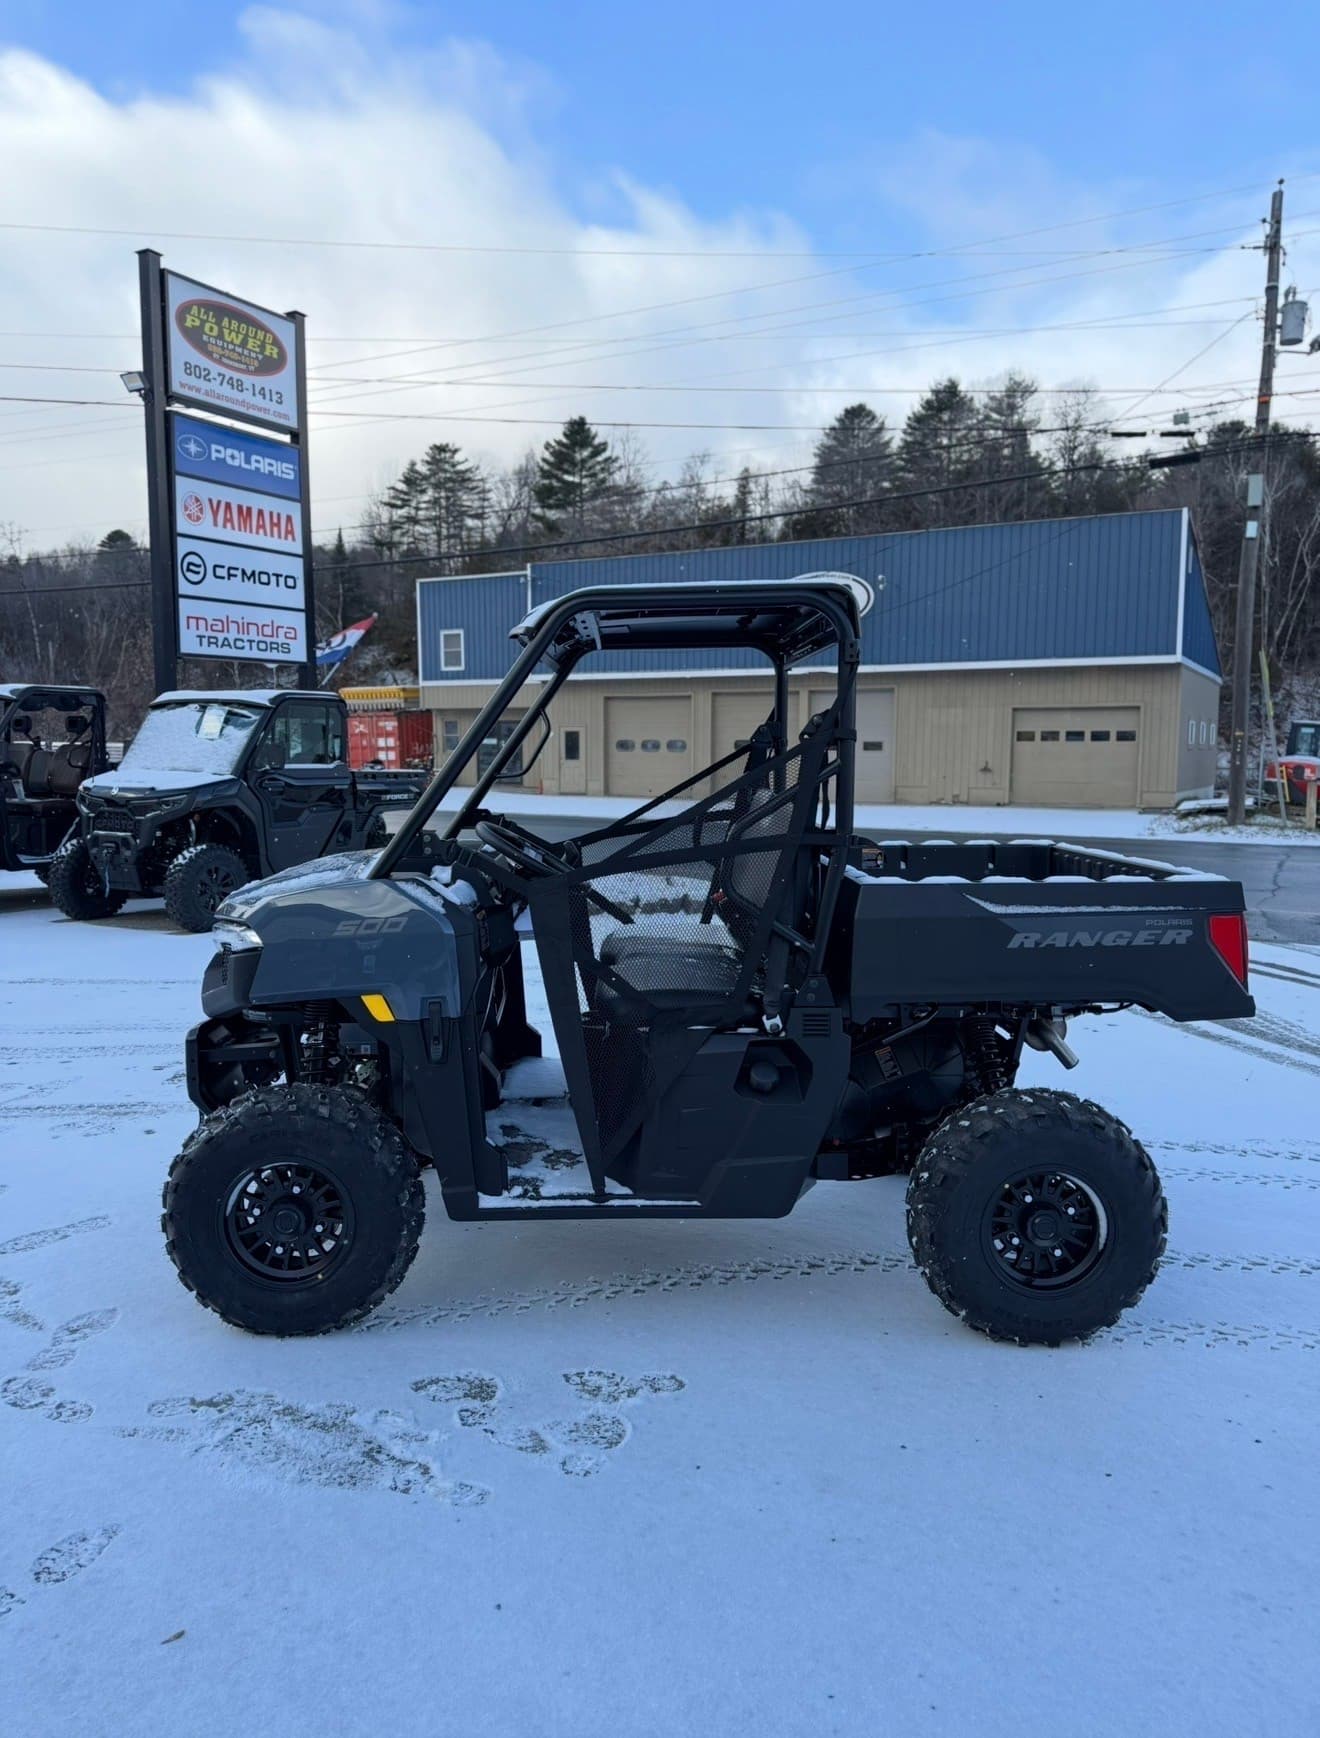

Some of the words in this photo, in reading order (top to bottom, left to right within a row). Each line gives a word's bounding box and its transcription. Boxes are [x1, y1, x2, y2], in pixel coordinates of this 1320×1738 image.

[184, 314, 279, 359] POWER
[190, 305, 216, 323] ALL
[222, 317, 273, 344] AROUND
[203, 334, 263, 360] EQUIPMENT
[184, 362, 283, 404] 802-748-1413
[179, 381, 290, 420] www.allaroundpower.com
[211, 444, 295, 480] POLARIS
[208, 498, 296, 542] YAMAHA
[212, 564, 297, 590] CFMOTO
[186, 615, 297, 641] mahindra
[196, 635, 291, 654] TRACTORS
[331, 917, 409, 936] 500
[1145, 919, 1193, 928] POLARIS
[1007, 929, 1194, 949] RANGER
